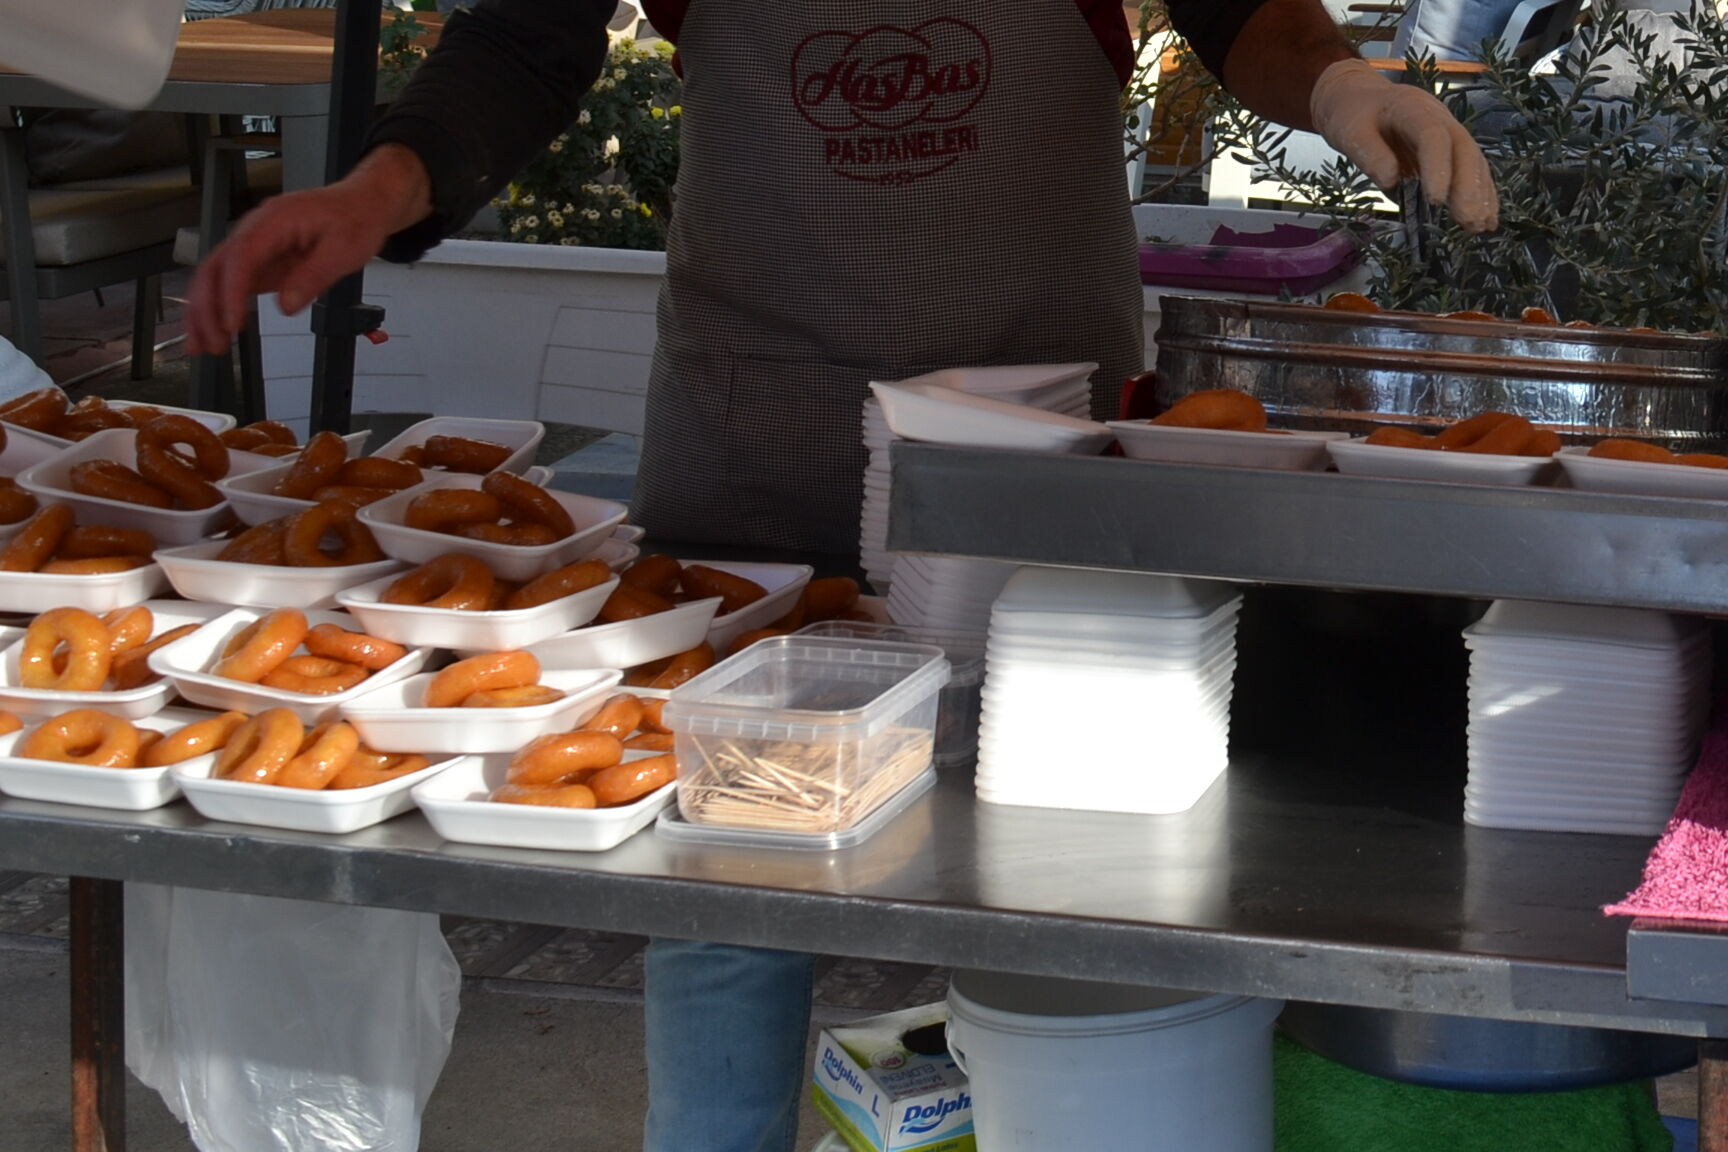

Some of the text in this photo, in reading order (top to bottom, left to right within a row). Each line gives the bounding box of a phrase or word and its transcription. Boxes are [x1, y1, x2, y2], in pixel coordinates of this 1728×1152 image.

[802, 52, 980, 111] HasBas
[823, 1047, 864, 1095] Dolphin
[902, 1093, 971, 1123] Dolph
